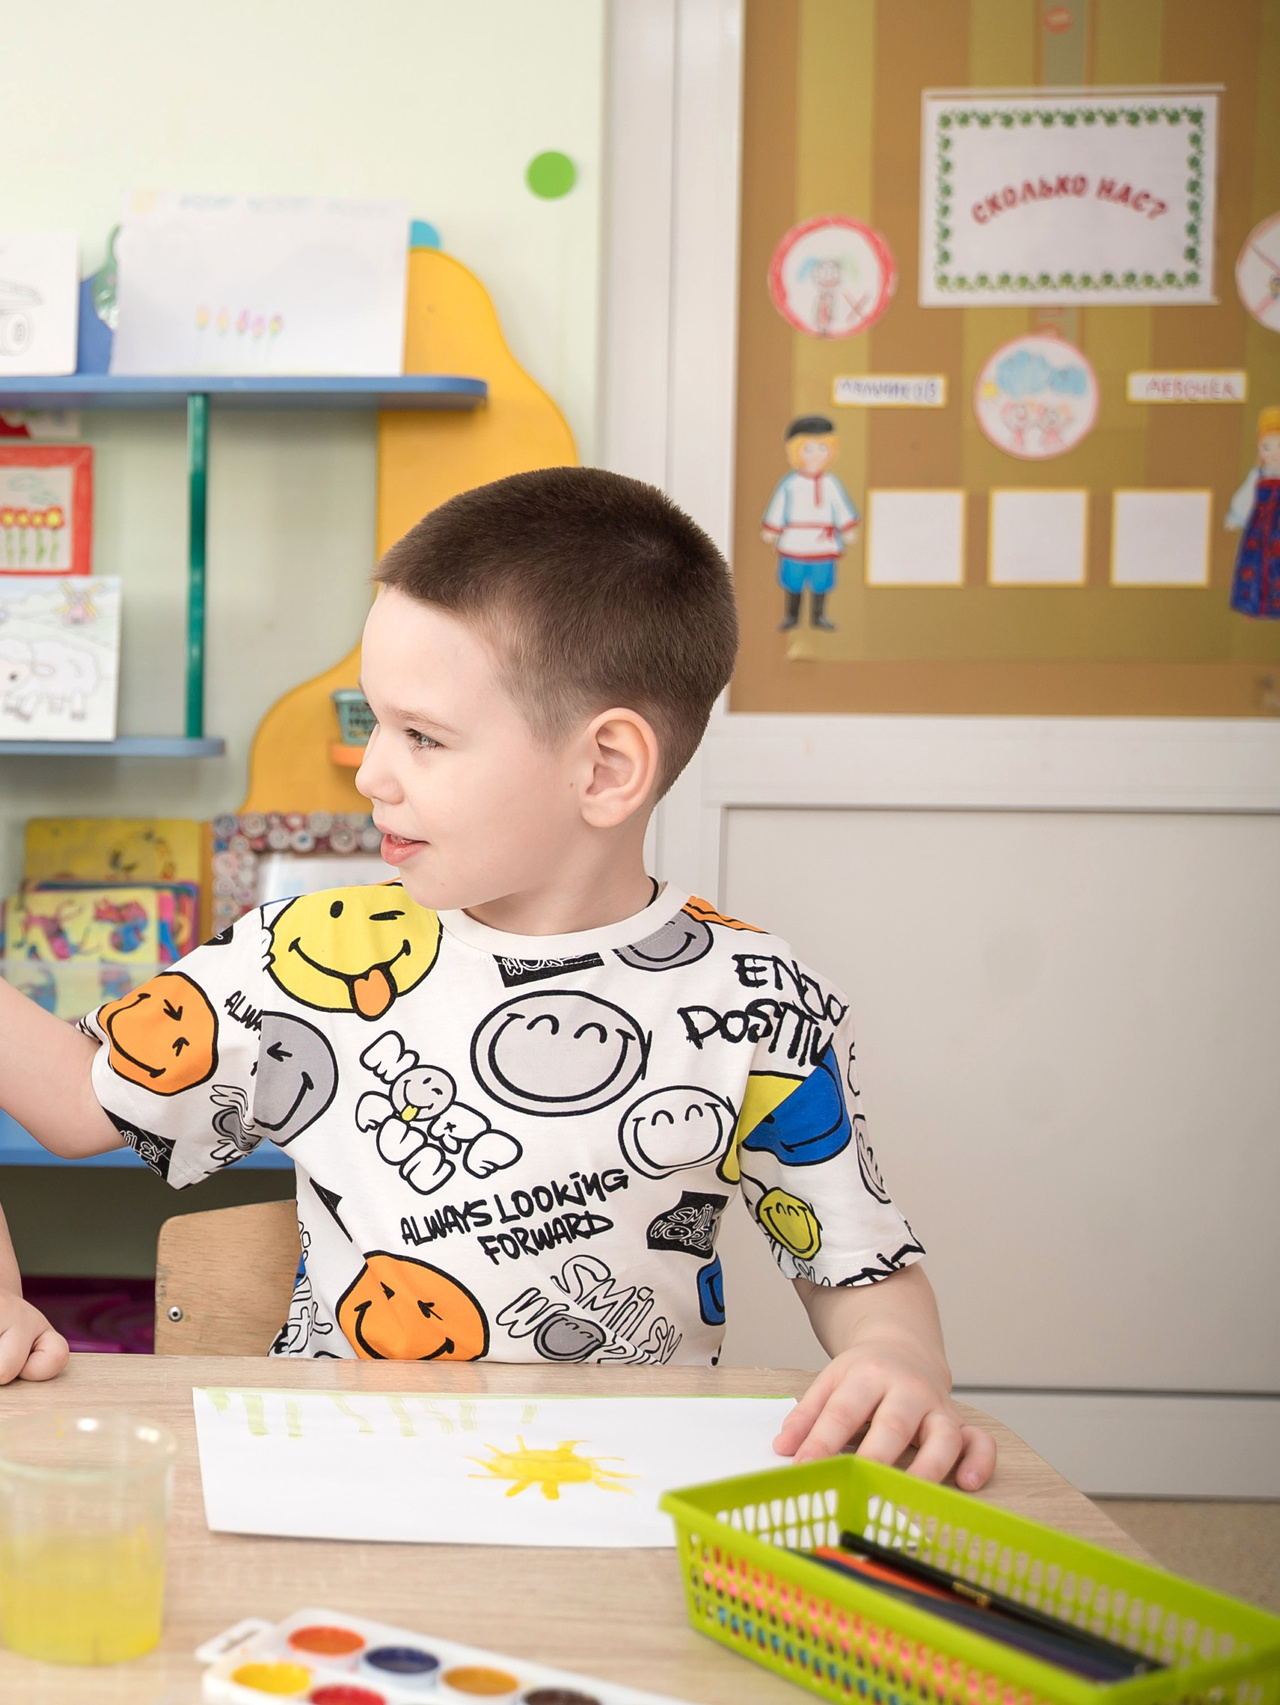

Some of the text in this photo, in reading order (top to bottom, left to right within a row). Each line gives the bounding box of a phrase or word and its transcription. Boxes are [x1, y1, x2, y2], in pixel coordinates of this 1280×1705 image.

[971, 174, 1168, 226] СКОЛЬКО НАС?
[224, 990, 263, 1032] ALWA
[731, 953, 850, 1027] ENJO
[401, 1199, 493, 1246] ALWAYS
[477, 1210, 614, 1266] FORWARD
